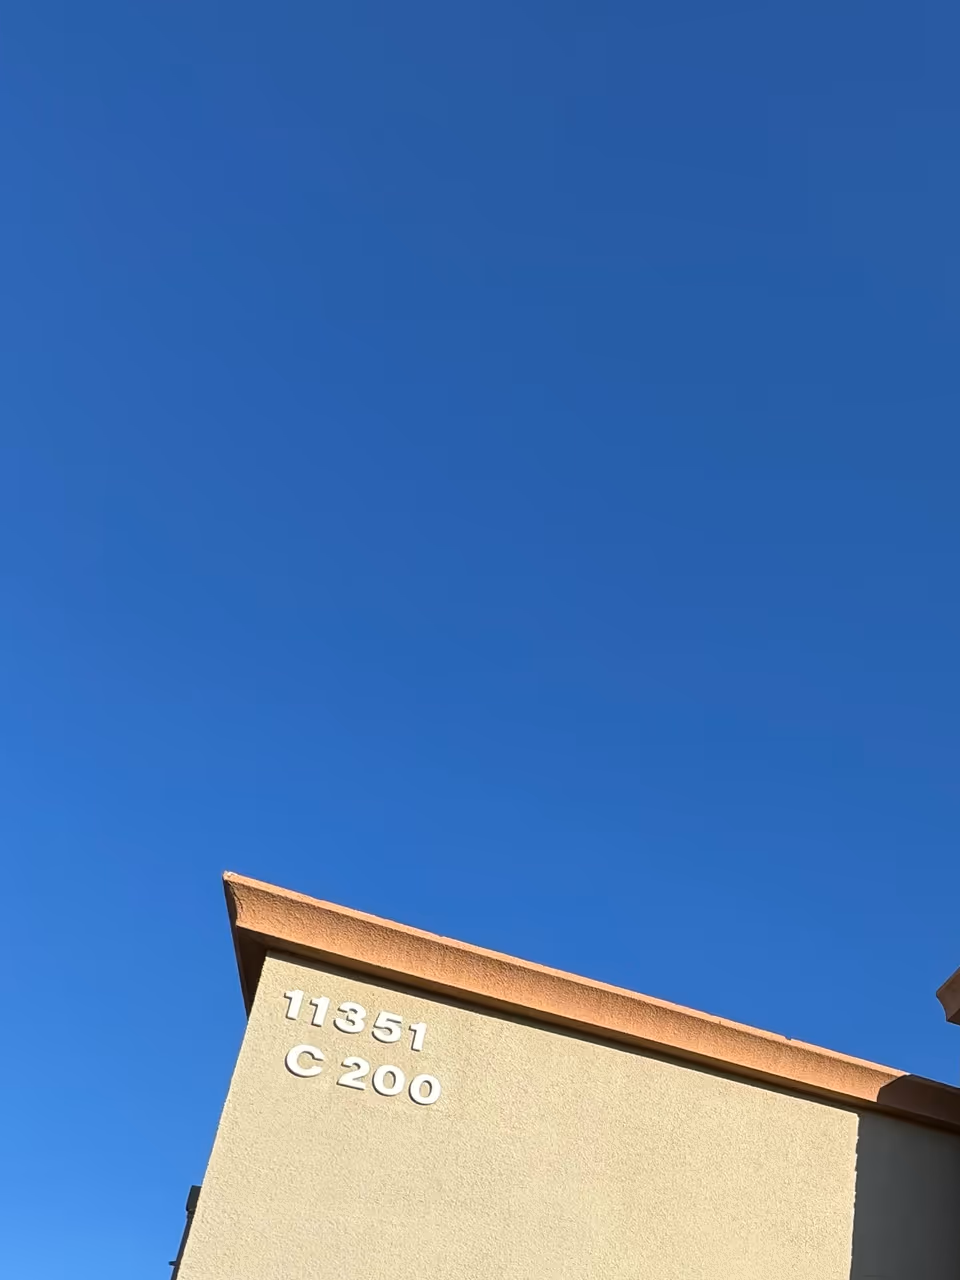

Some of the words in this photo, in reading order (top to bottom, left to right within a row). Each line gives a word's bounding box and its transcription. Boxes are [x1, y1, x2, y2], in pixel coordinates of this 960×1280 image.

[284, 989, 428, 1051] 11351
[284, 1044, 325, 1078] C
[337, 1056, 442, 1106] 200
